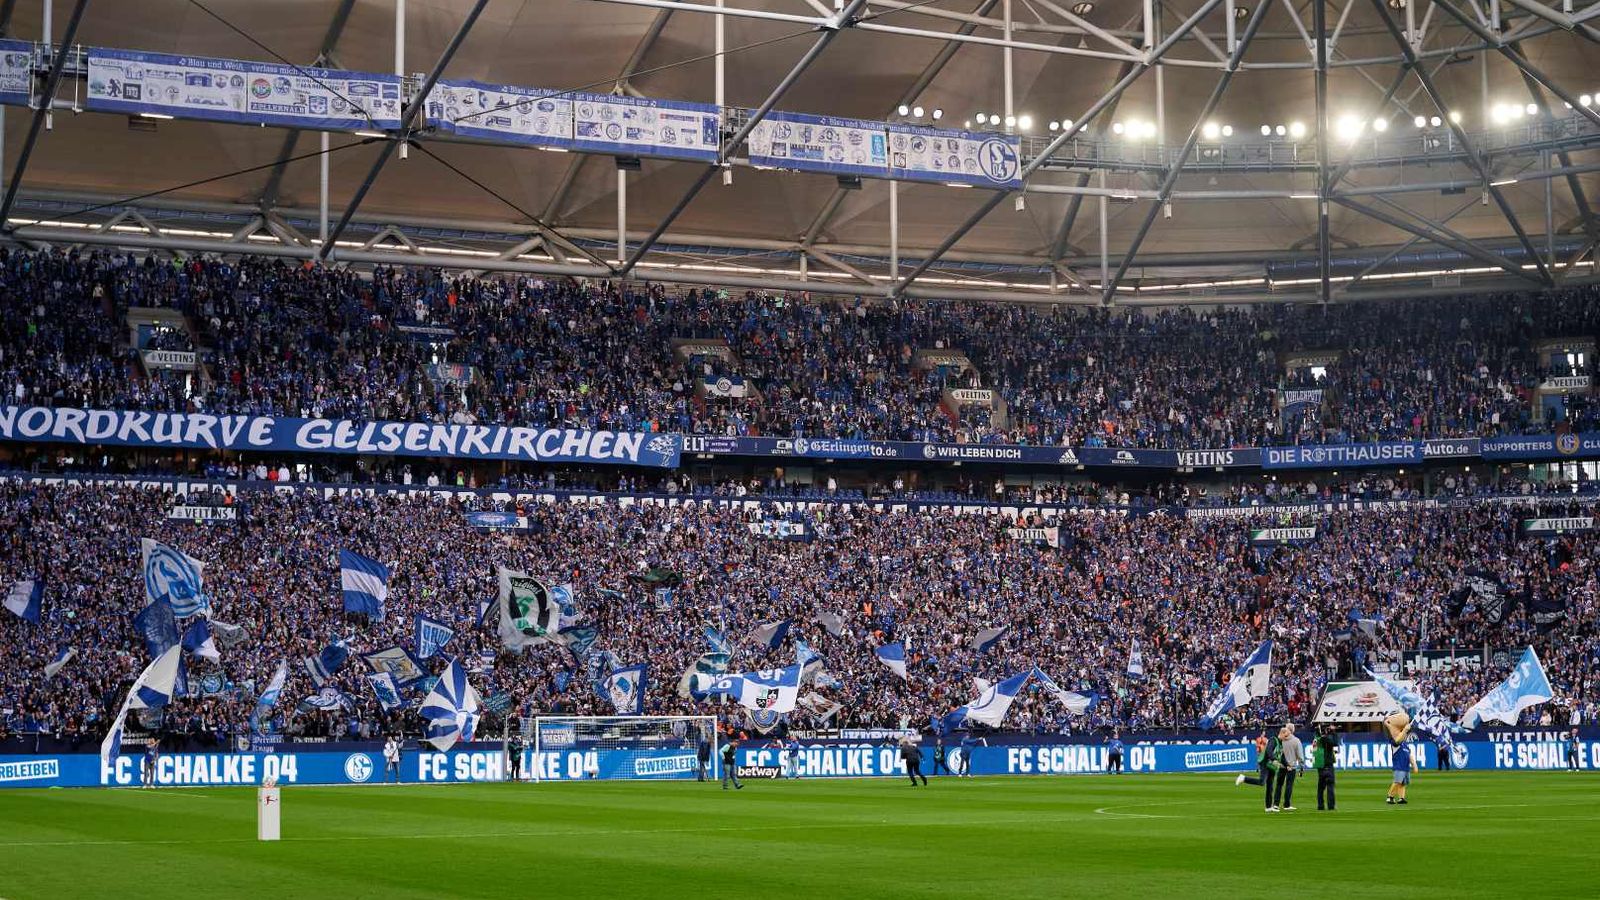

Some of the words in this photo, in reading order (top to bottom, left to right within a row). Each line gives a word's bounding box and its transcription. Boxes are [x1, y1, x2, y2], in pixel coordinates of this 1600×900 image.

[158, 353, 194, 364] VELTINS
[1554, 377, 1588, 387] VELTINS
[960, 390, 991, 401] VELTINS
[0, 405, 275, 449] NORDKURVE
[295, 418, 645, 462] GELSENKIRCHEN
[938, 446, 959, 457] WIR
[960, 447, 993, 458] LEBEN
[995, 448, 1021, 460] DICH
[1424, 442, 1469, 456] Auto.de
[1483, 440, 1553, 452] SUPPORTERS
[1176, 450, 1234, 466] VELTINS
[1268, 448, 1296, 464] DIE
[1547, 519, 1588, 530] VELTINS
[1017, 529, 1047, 540] VELTIN
[1273, 528, 1312, 539] VELTINS
[1008, 748, 1032, 773] FC
[1130, 746, 1156, 772] 04
[1187, 750, 1246, 767] #WIRBLEIBEN
[1495, 743, 1514, 768] FC
[101, 756, 132, 784] FC
[263, 755, 298, 783] 04
[419, 753, 448, 780] FC
[455, 752, 560, 780] SCHLKE
[568, 752, 598, 780] 04
[636, 757, 701, 774] #WIRBLEIB
[737, 766, 779, 779] betway
